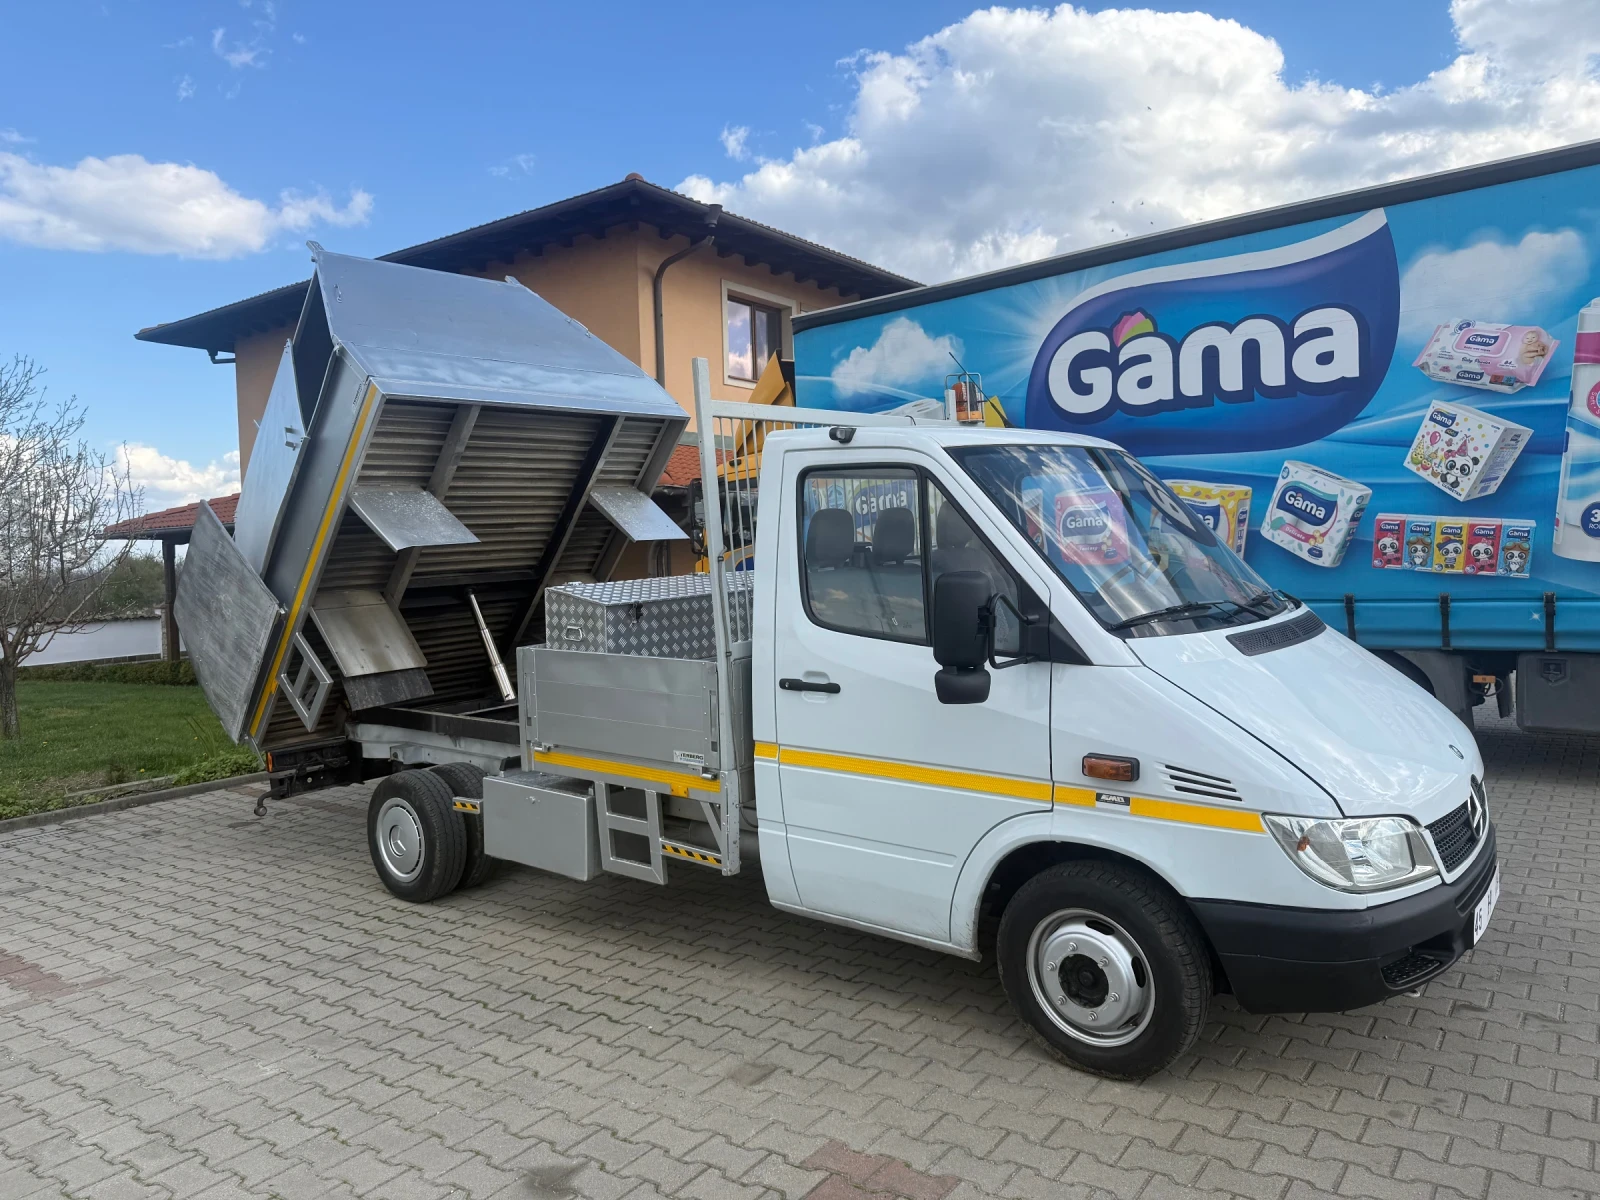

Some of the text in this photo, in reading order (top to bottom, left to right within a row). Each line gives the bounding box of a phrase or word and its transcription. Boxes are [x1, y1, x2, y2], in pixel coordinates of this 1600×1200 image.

[1470, 335, 1495, 344] Gama
[1049, 307, 1360, 414] Gama
[1458, 371, 1481, 380] Gama
[1432, 412, 1452, 426] Gama
[1285, 490, 1326, 520] Gama
[1066, 512, 1104, 529] Gama
